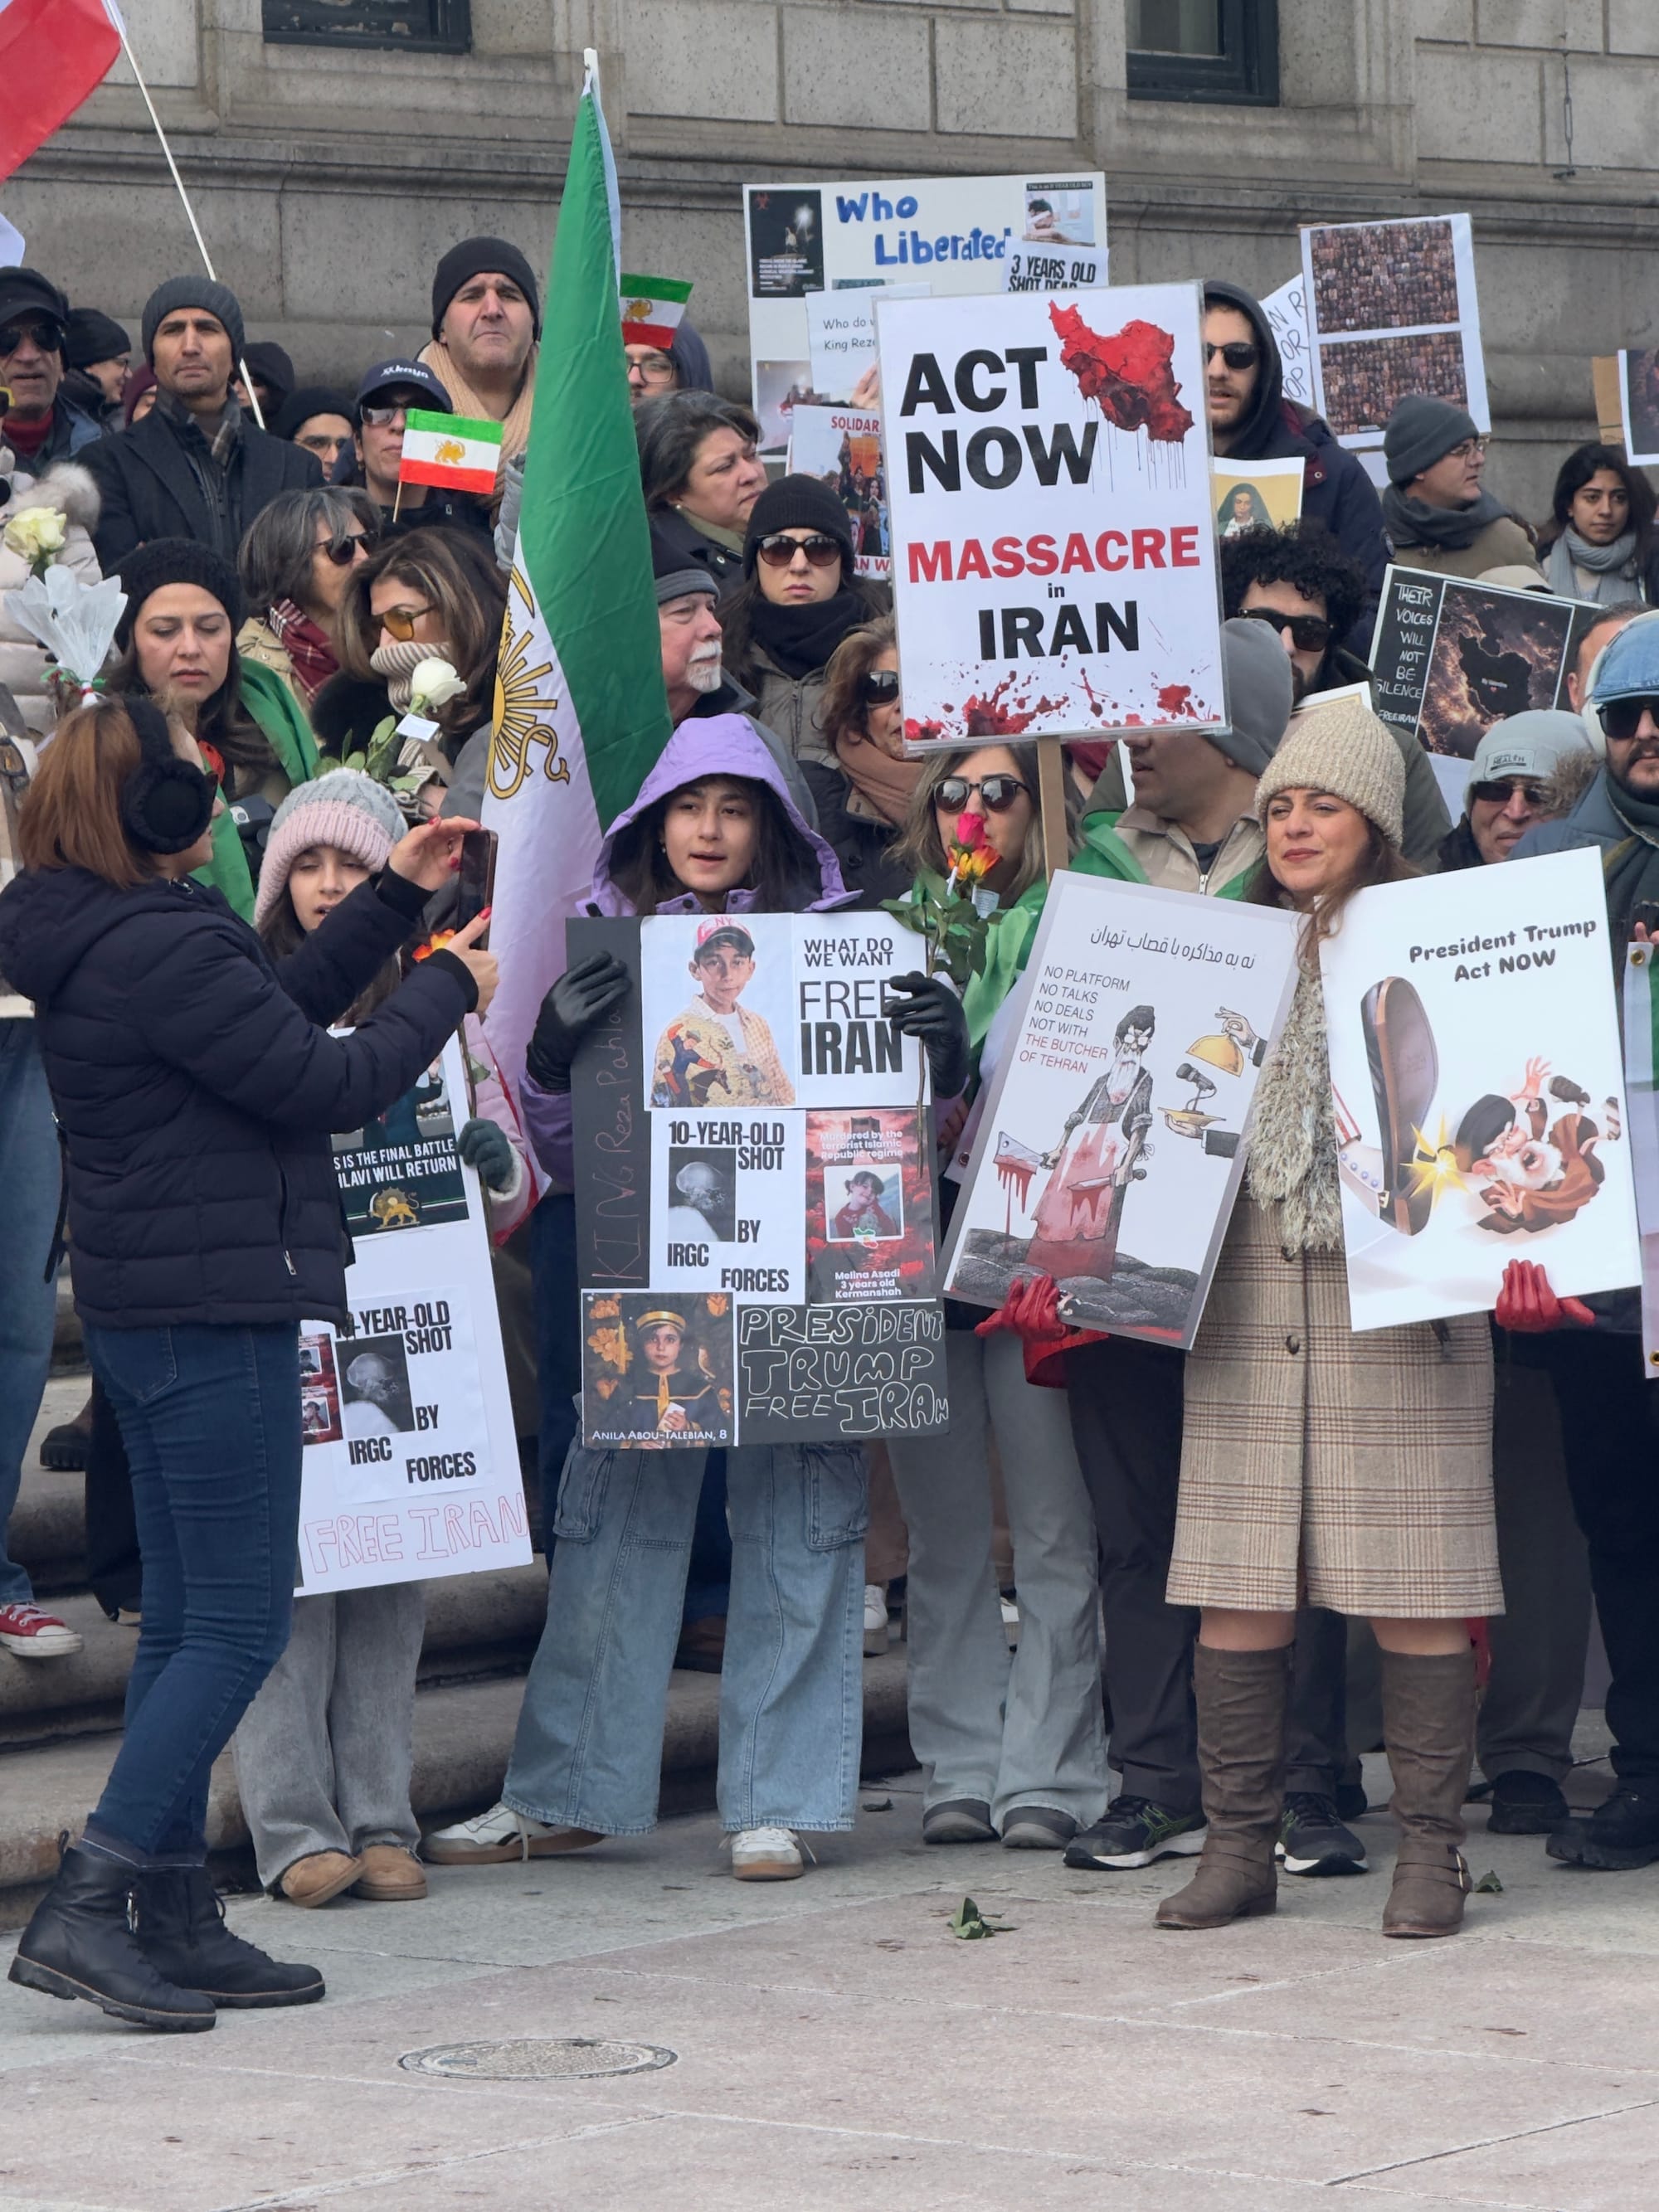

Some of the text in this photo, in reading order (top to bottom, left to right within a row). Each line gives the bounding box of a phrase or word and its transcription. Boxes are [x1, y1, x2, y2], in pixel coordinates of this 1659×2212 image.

[835, 192, 918, 223] Who
[874, 227, 1011, 265] Liberated
[1011, 255, 1097, 284] 3 YEARS OLD
[1009, 275, 1042, 292] SHOT
[823, 319, 849, 329] Who
[853, 316, 867, 327] do
[824, 339, 848, 352] King
[899, 347, 1048, 416] ACT
[831, 416, 880, 432] SOLIDAR
[905, 421, 1098, 493] NOW
[907, 526, 1199, 583] MASSACRE
[1047, 583, 1065, 598] in
[1394, 582, 1433, 607] THEIR
[1396, 608, 1434, 626] VOICES
[978, 600, 1140, 660] IRAN
[1399, 630, 1426, 646] WILL
[1399, 650, 1425, 664] NOT
[1395, 665, 1417, 681] BE
[1376, 678, 1423, 699] SILENCE
[804, 937, 893, 953] WHAT DO
[1090, 925, 1126, 948] تهران
[1127, 932, 1169, 954] قصاب
[1409, 920, 1597, 963] President Trump
[804, 951, 893, 967] WE WANT
[1224, 953, 1238, 971] به
[1240, 953, 1258, 970] نه
[1454, 948, 1556, 983] Act NOW
[1044, 965, 1131, 992] NO PLATFORM
[800, 980, 901, 1020] FREE
[1039, 983, 1098, 1004] NO TALKS
[1034, 999, 1094, 1021] NO DEALS
[1029, 1017, 1088, 1038] NOT WITH
[800, 1020, 902, 1075] IRAN
[1025, 1033, 1108, 1060] THE BUTCHER
[1019, 1050, 1088, 1074] OF TEHRAN
[668, 1121, 785, 1145] 10-YEAR-OLD
[820, 1129, 903, 1141] Murdered by the
[821, 1140, 902, 1150] terrorist Islamic
[343, 1155, 354, 1169] IS
[356, 1149, 378, 1166] THE
[379, 1145, 412, 1164] FINAL
[414, 1139, 455, 1157] BATTLE
[737, 1147, 785, 1170] SHOT
[821, 1149, 903, 1161] Republic regime
[372, 1164, 405, 1183] WILL
[406, 1155, 457, 1178] RETURN
[737, 1219, 761, 1243] BY
[667, 1242, 709, 1267] IRGC
[721, 1268, 790, 1292] FORCES
[834, 1268, 900, 1281] Melina Asadi
[840, 1278, 896, 1291] 3 years old
[834, 1287, 902, 1299] Kermanshah
[405, 1325, 452, 1355] SHOT
[741, 1346, 935, 1396] TRUMP
[416, 1404, 439, 1431] BY
[745, 1394, 832, 1419] FREE
[719, 1429, 727, 1440] 8
[348, 1437, 392, 1466] IRGC
[406, 1451, 476, 1483] FORCES
[304, 1492, 529, 1573] FREE IRAN
